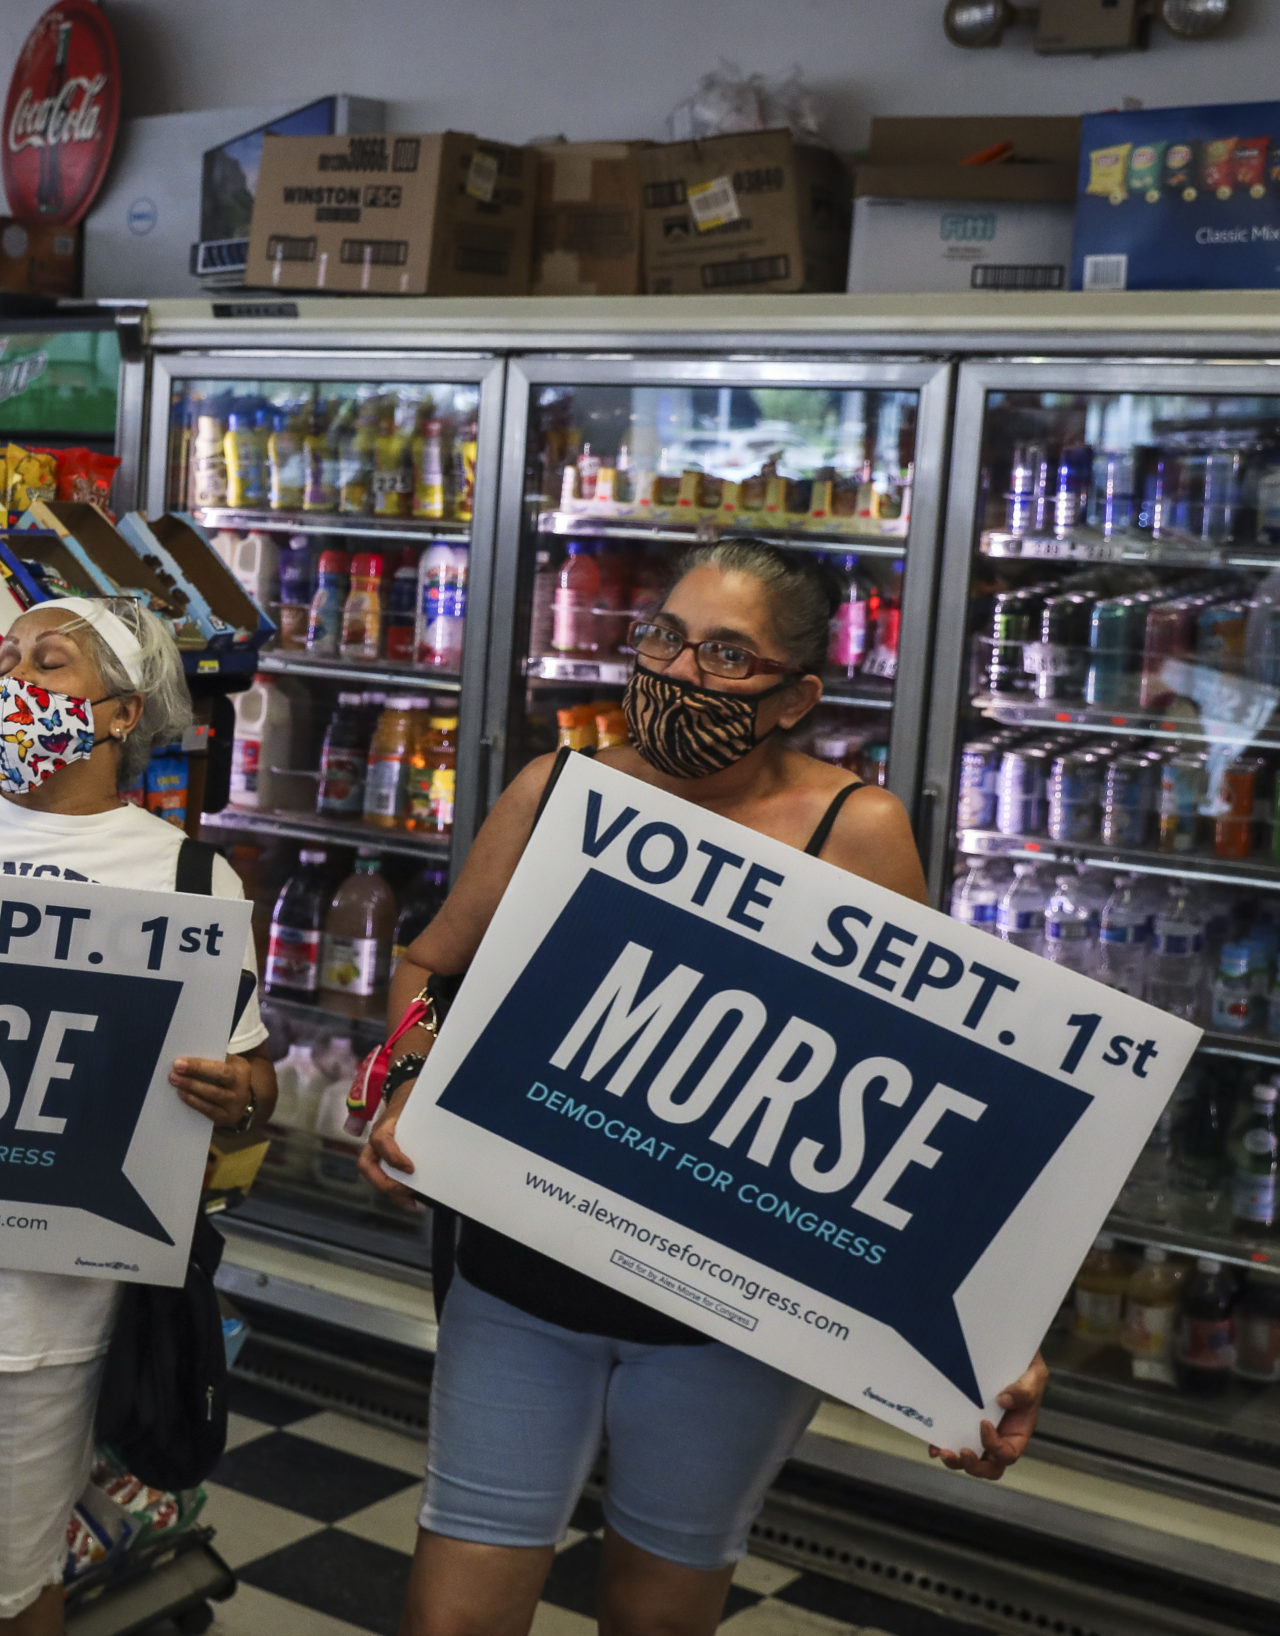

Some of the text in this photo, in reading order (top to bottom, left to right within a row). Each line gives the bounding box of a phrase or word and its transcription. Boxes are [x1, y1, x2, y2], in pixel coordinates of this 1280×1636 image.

[284, 187, 360, 205] WINSTON
[1195, 226, 1248, 244] Classic
[140, 915, 224, 970] 1st
[582, 789, 1159, 1078] VOTE SEPT. 1st
[548, 940, 988, 1232] MORSE
[525, 1081, 887, 1265] DEMOCRAT FOR CONGRESS
[525, 1171, 850, 1341] www.alexmorseforcongress.com
[617, 1255, 750, 1326] Paid for by Alex Morse for Congress
